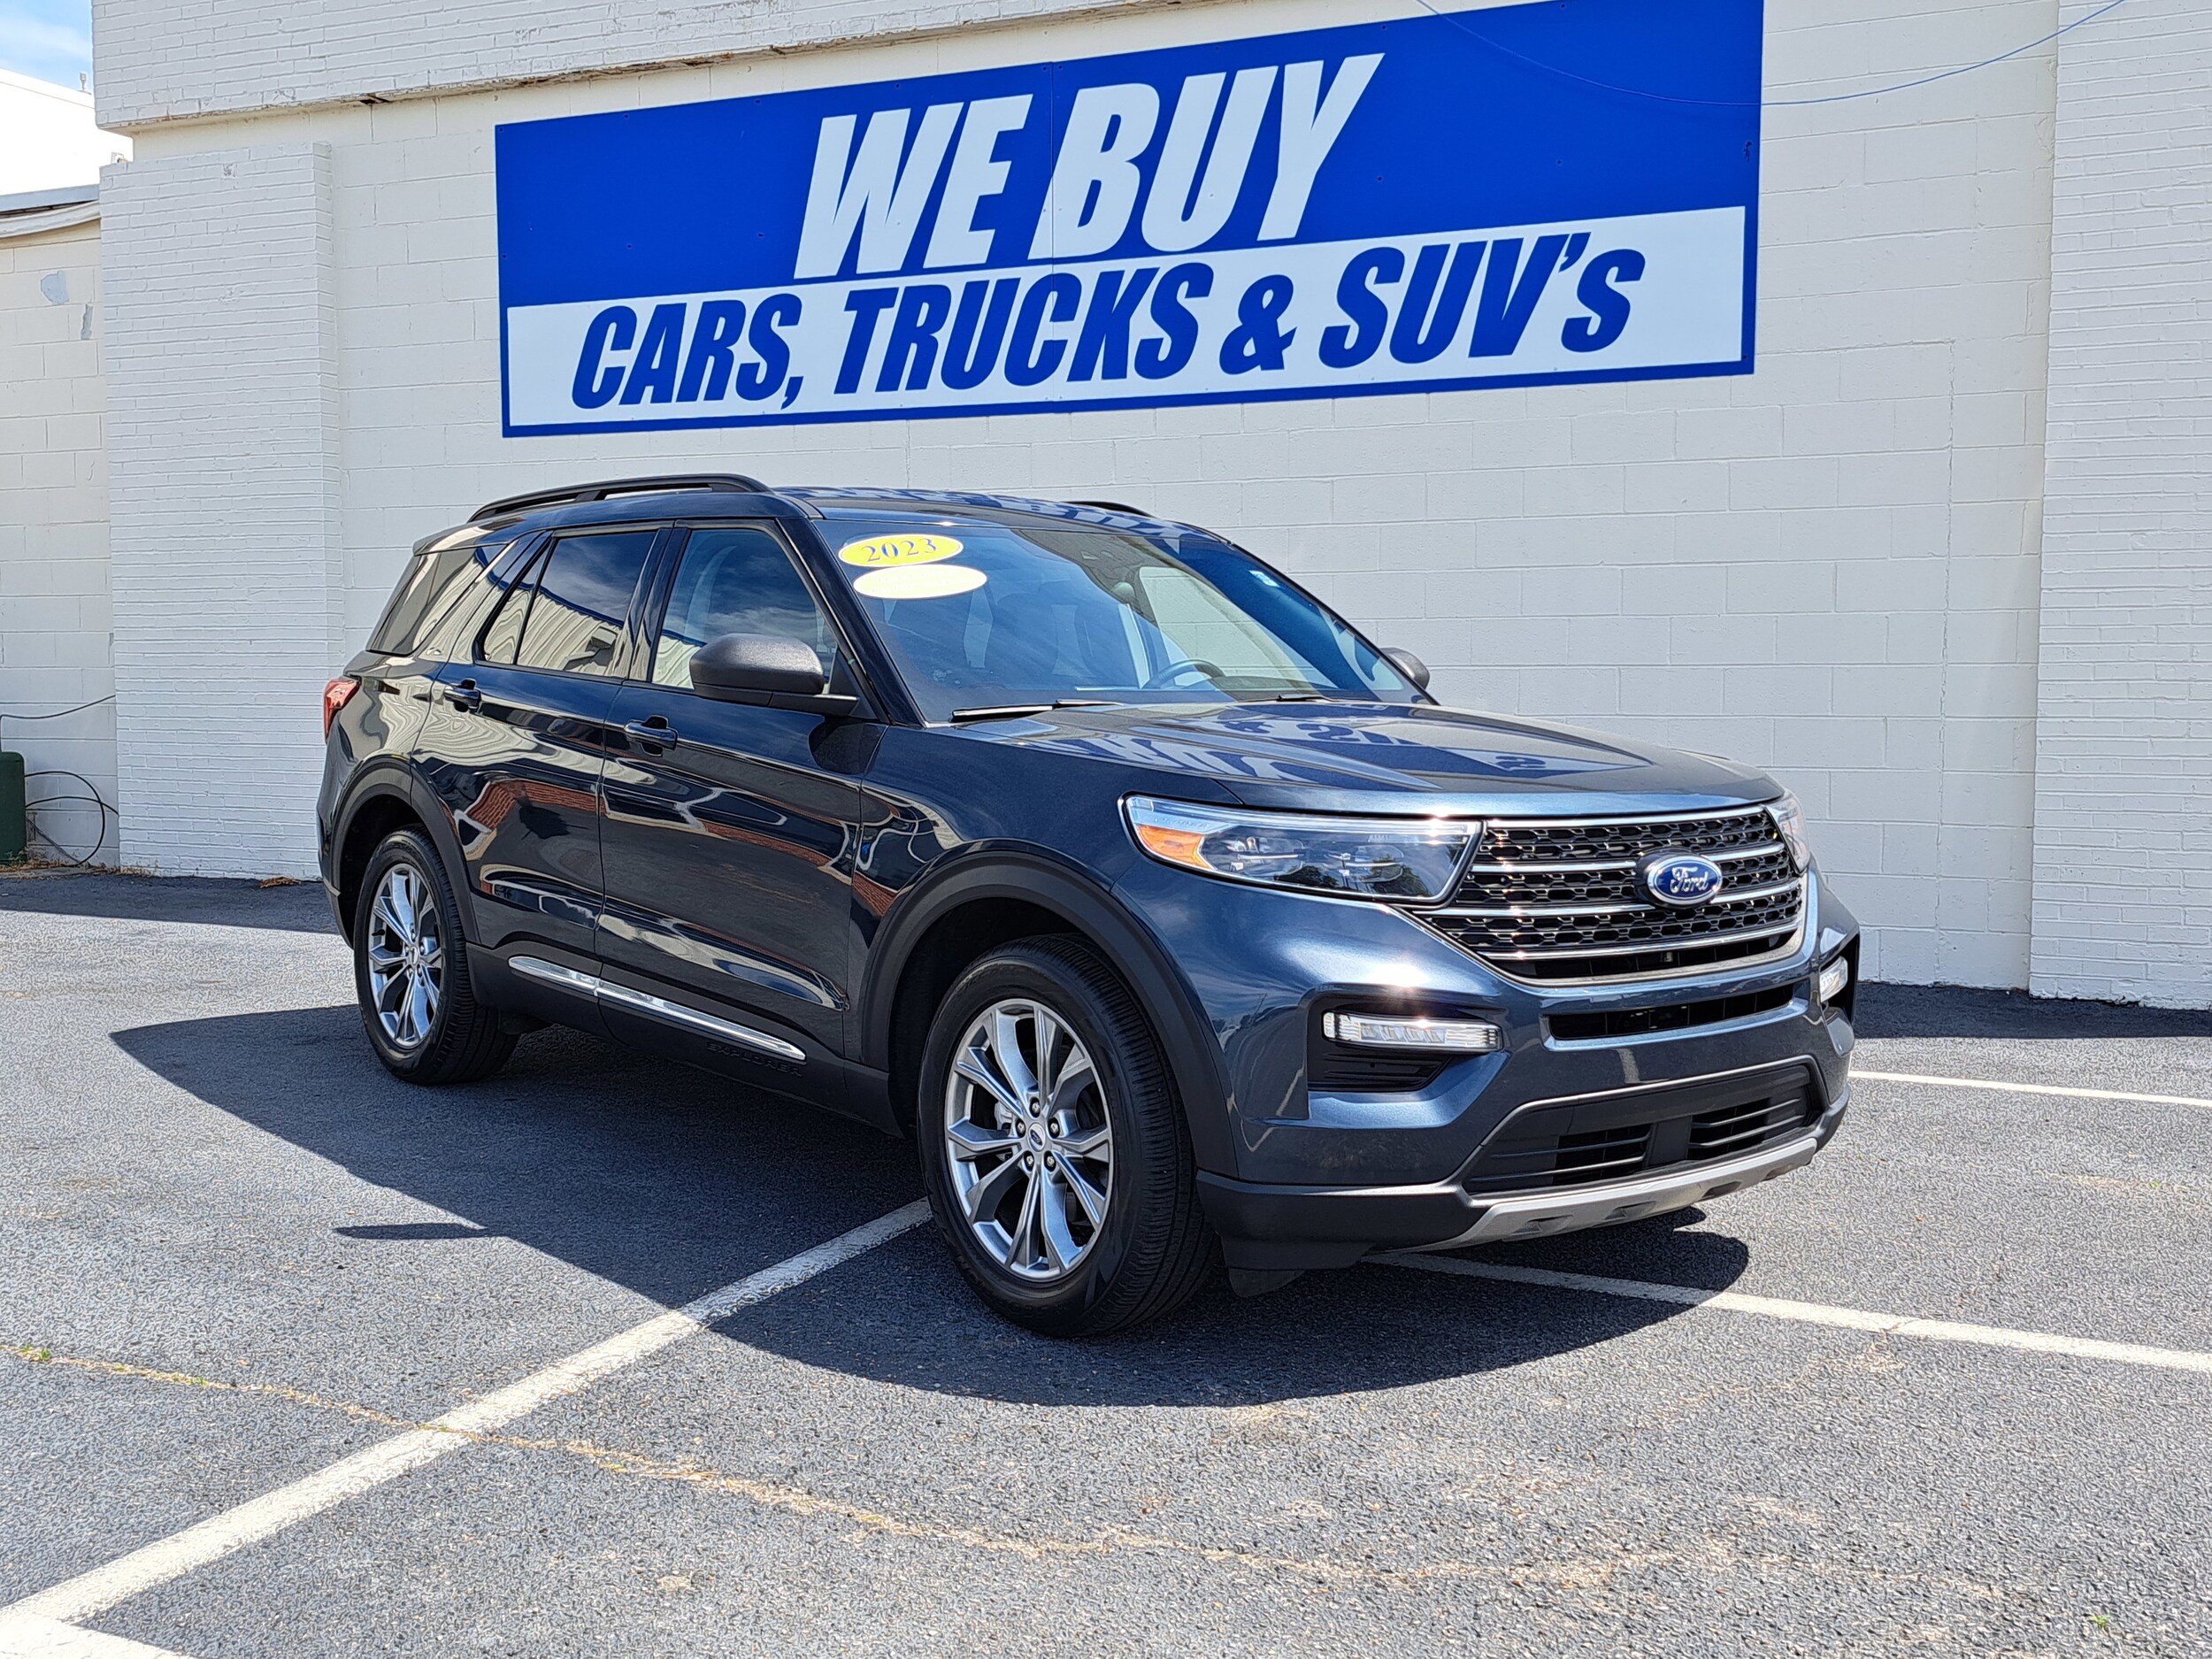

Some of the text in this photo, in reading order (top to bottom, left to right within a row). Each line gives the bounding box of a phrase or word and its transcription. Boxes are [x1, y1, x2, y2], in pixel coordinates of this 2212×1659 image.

[794, 53, 1385, 279] WE BUY
[571, 292, 804, 411] CARS,
[833, 262, 1215, 396] TRUCKS
[1218, 273, 1298, 376] &
[861, 537, 938, 563] 2023
[1669, 866, 1709, 894] Ford
[706, 1041, 803, 1078] EXPLORER
